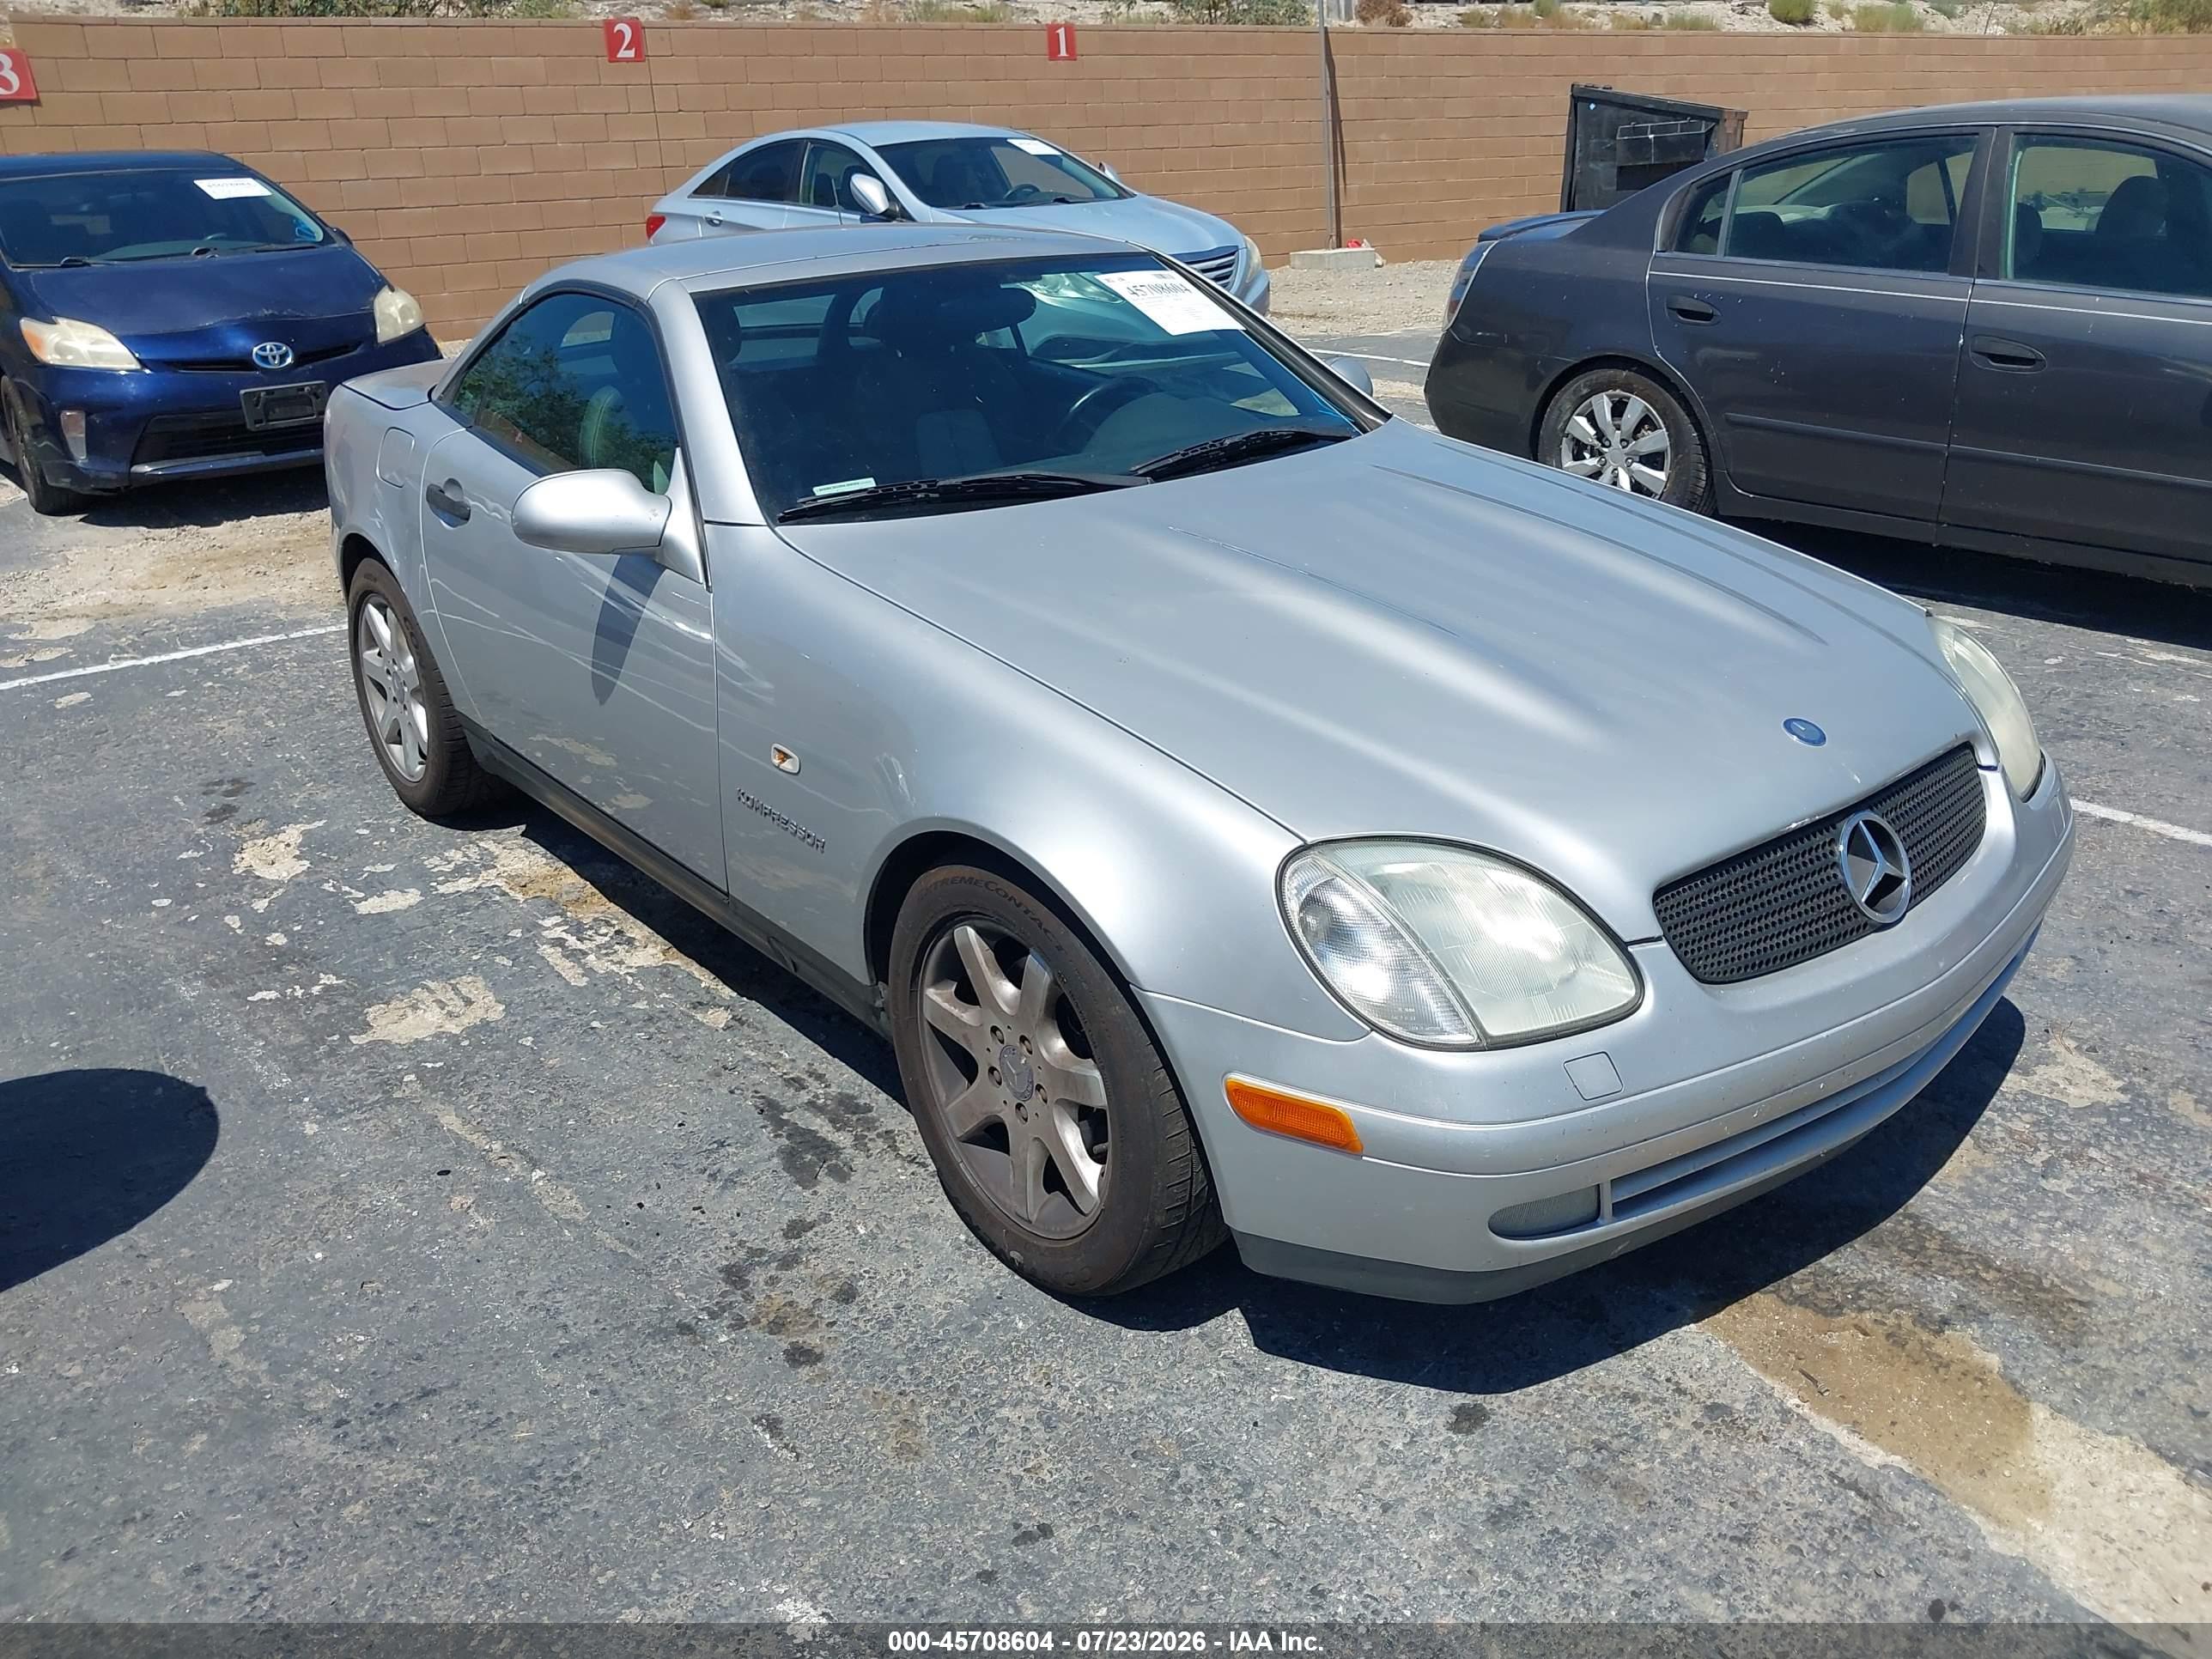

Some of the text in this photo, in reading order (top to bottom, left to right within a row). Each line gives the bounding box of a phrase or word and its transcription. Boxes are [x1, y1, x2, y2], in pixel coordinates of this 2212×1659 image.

[613, 22, 636, 58] 2
[1055, 27, 1070, 58] 1
[1127, 282, 1193, 297] 45708604
[737, 787, 826, 854] KOMPRESSOR
